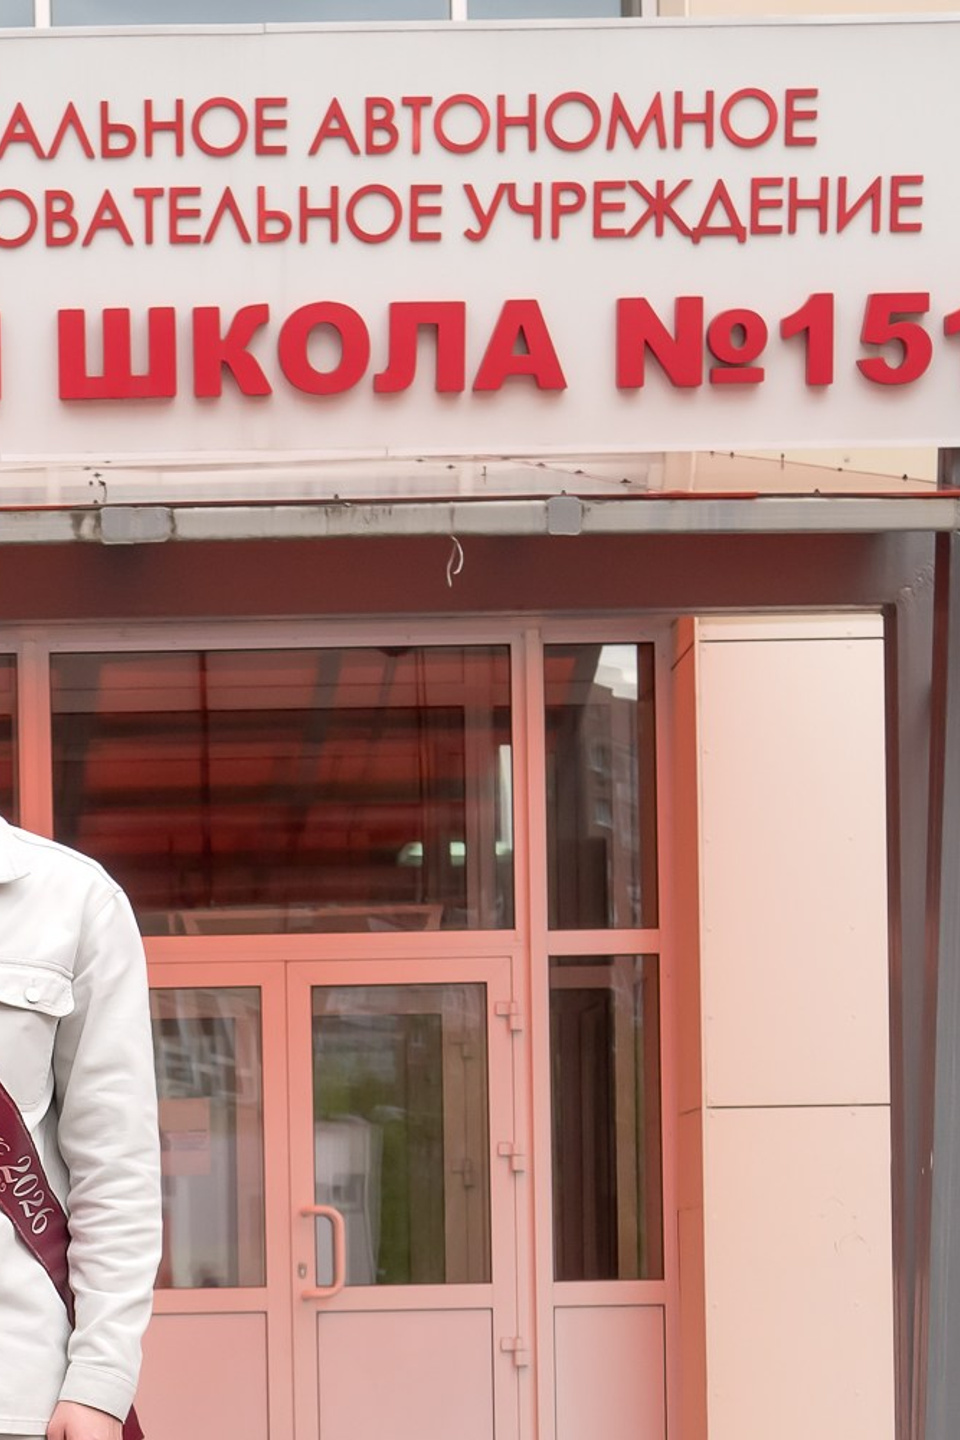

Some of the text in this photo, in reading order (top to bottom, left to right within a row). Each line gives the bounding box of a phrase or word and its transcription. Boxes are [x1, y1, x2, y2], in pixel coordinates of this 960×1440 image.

[309, 87, 819, 156] АВТОНОМНОЕ
[463, 174, 924, 243] УЧРЕЖДЕНИЕ
[58, 300, 567, 401] ШКОЛА
